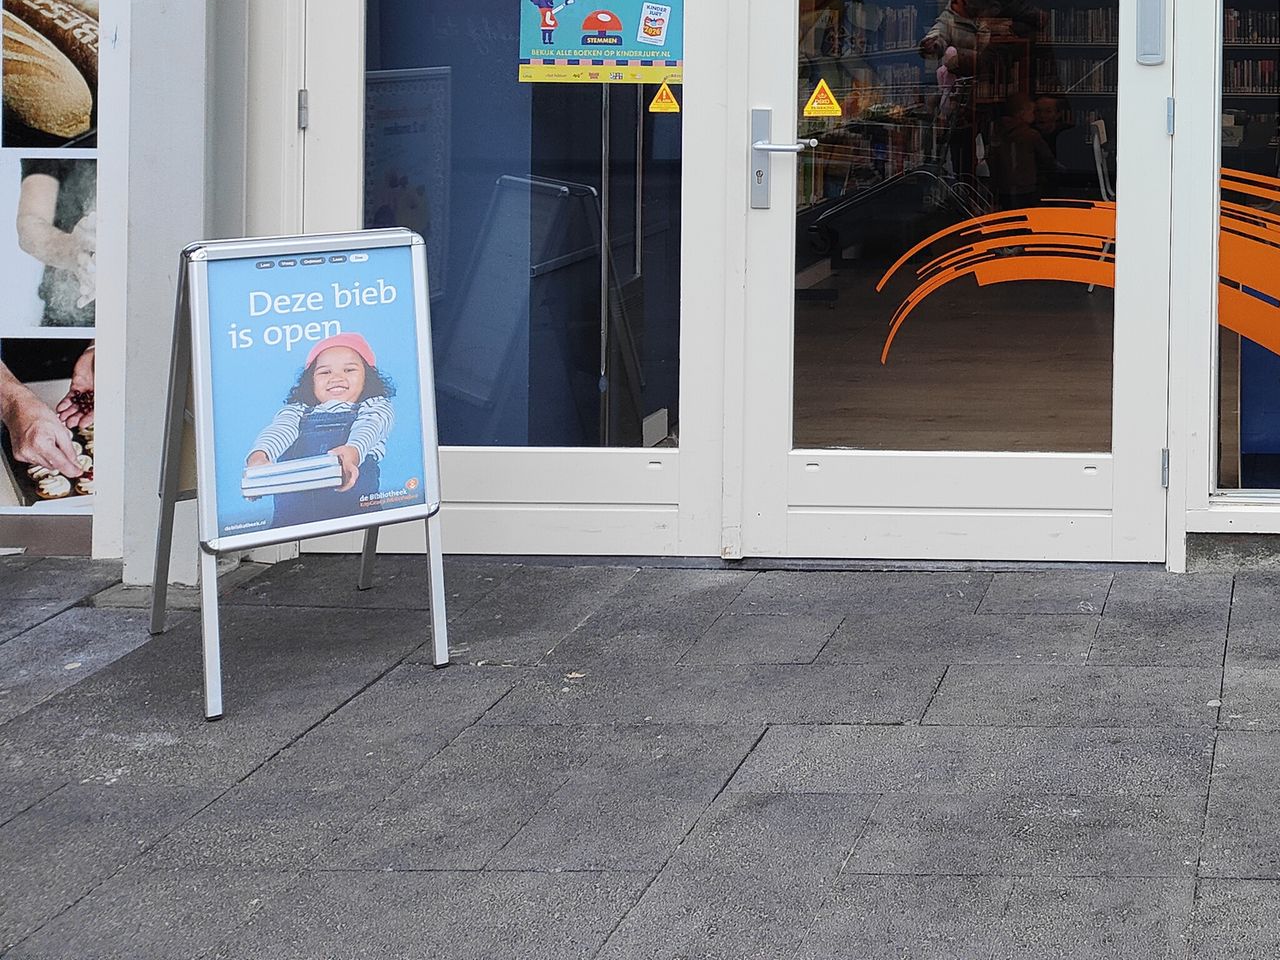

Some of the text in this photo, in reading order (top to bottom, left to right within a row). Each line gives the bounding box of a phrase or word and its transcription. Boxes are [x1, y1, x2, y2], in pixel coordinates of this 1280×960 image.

[646, 5, 668, 13] KINDER
[573, 49, 602, 57] BOEKEN
[250, 279, 397, 317] Deze bieb
[228, 318, 342, 352] is open
[359, 488, 408, 502] de Bibliotheek
